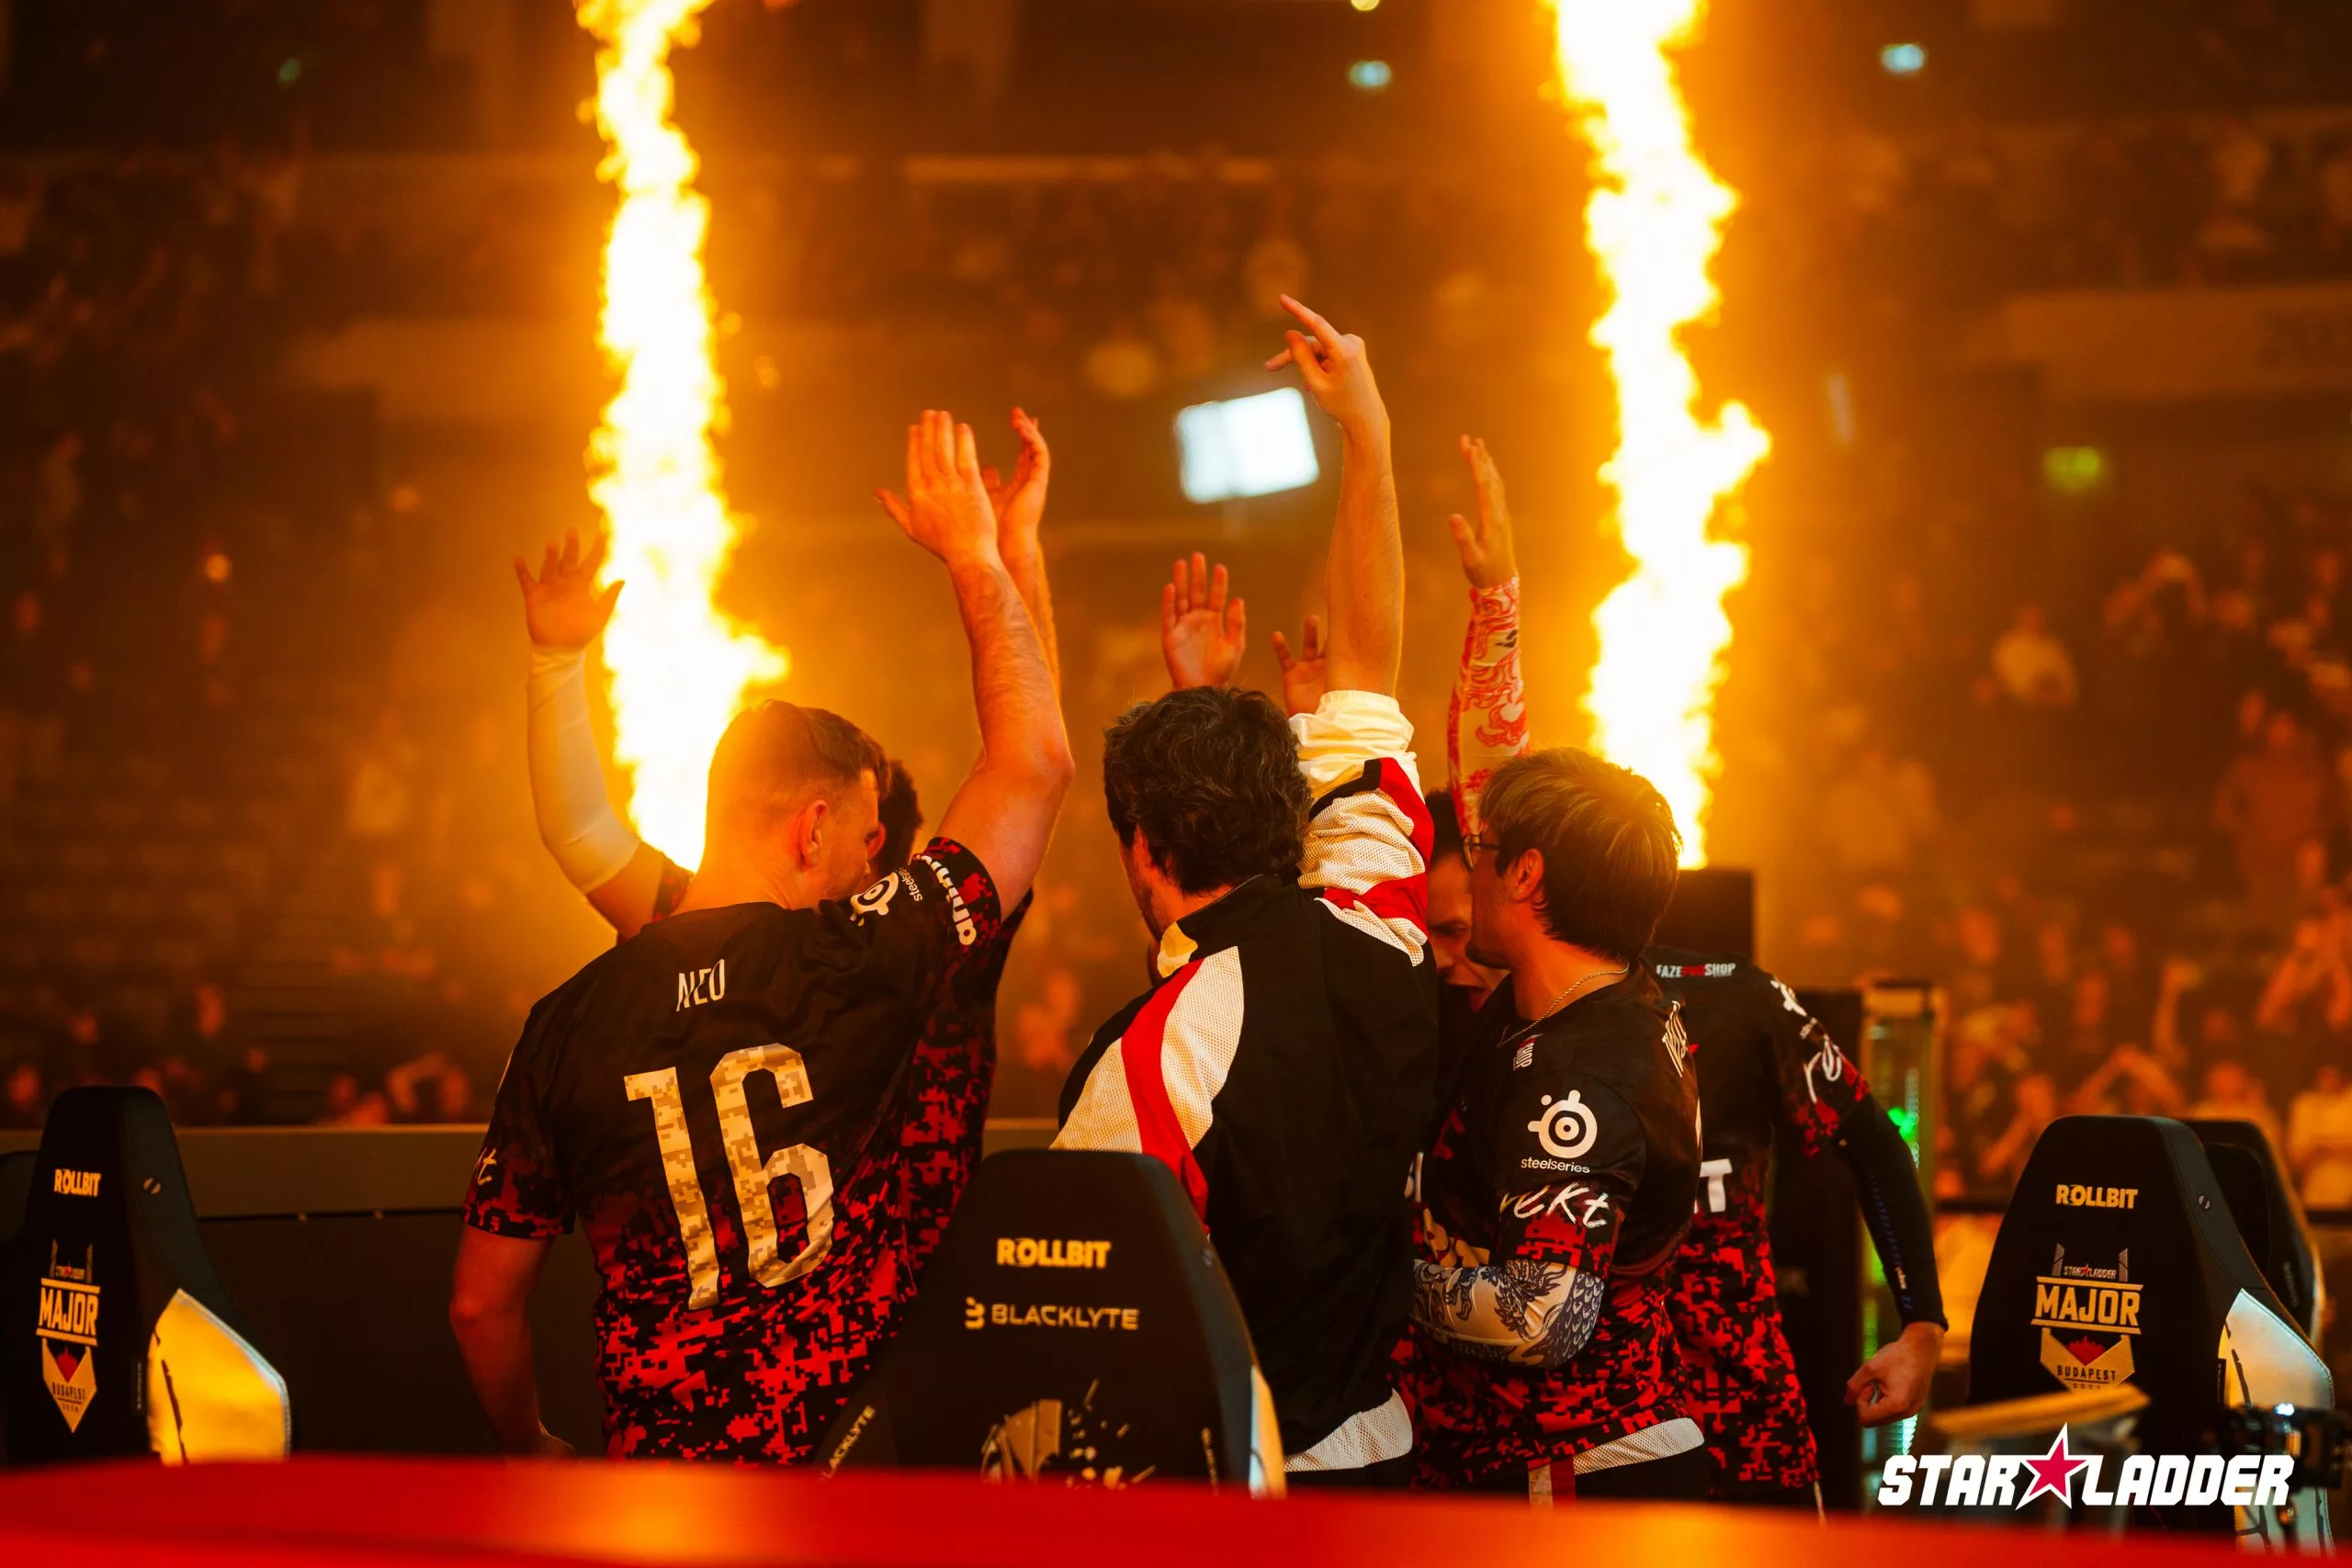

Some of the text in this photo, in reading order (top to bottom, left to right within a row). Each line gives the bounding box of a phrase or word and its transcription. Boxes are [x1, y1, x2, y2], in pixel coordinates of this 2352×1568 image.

[676, 958, 725, 1011] NEO
[624, 1043, 834, 1310] 16
[1521, 1157, 1590, 1174] steelseries
[54, 1168, 101, 1197] ROLLBIT
[2056, 1184, 2139, 1209] ROLLBIT
[997, 1238, 1112, 1269] ROLLBIT
[39, 1287, 99, 1336] MAJOR
[991, 1303, 1140, 1330] BLACKLYTE
[2035, 1284, 2141, 1326] MAJOR
[2057, 1365, 2117, 1381] BUDAPEST
